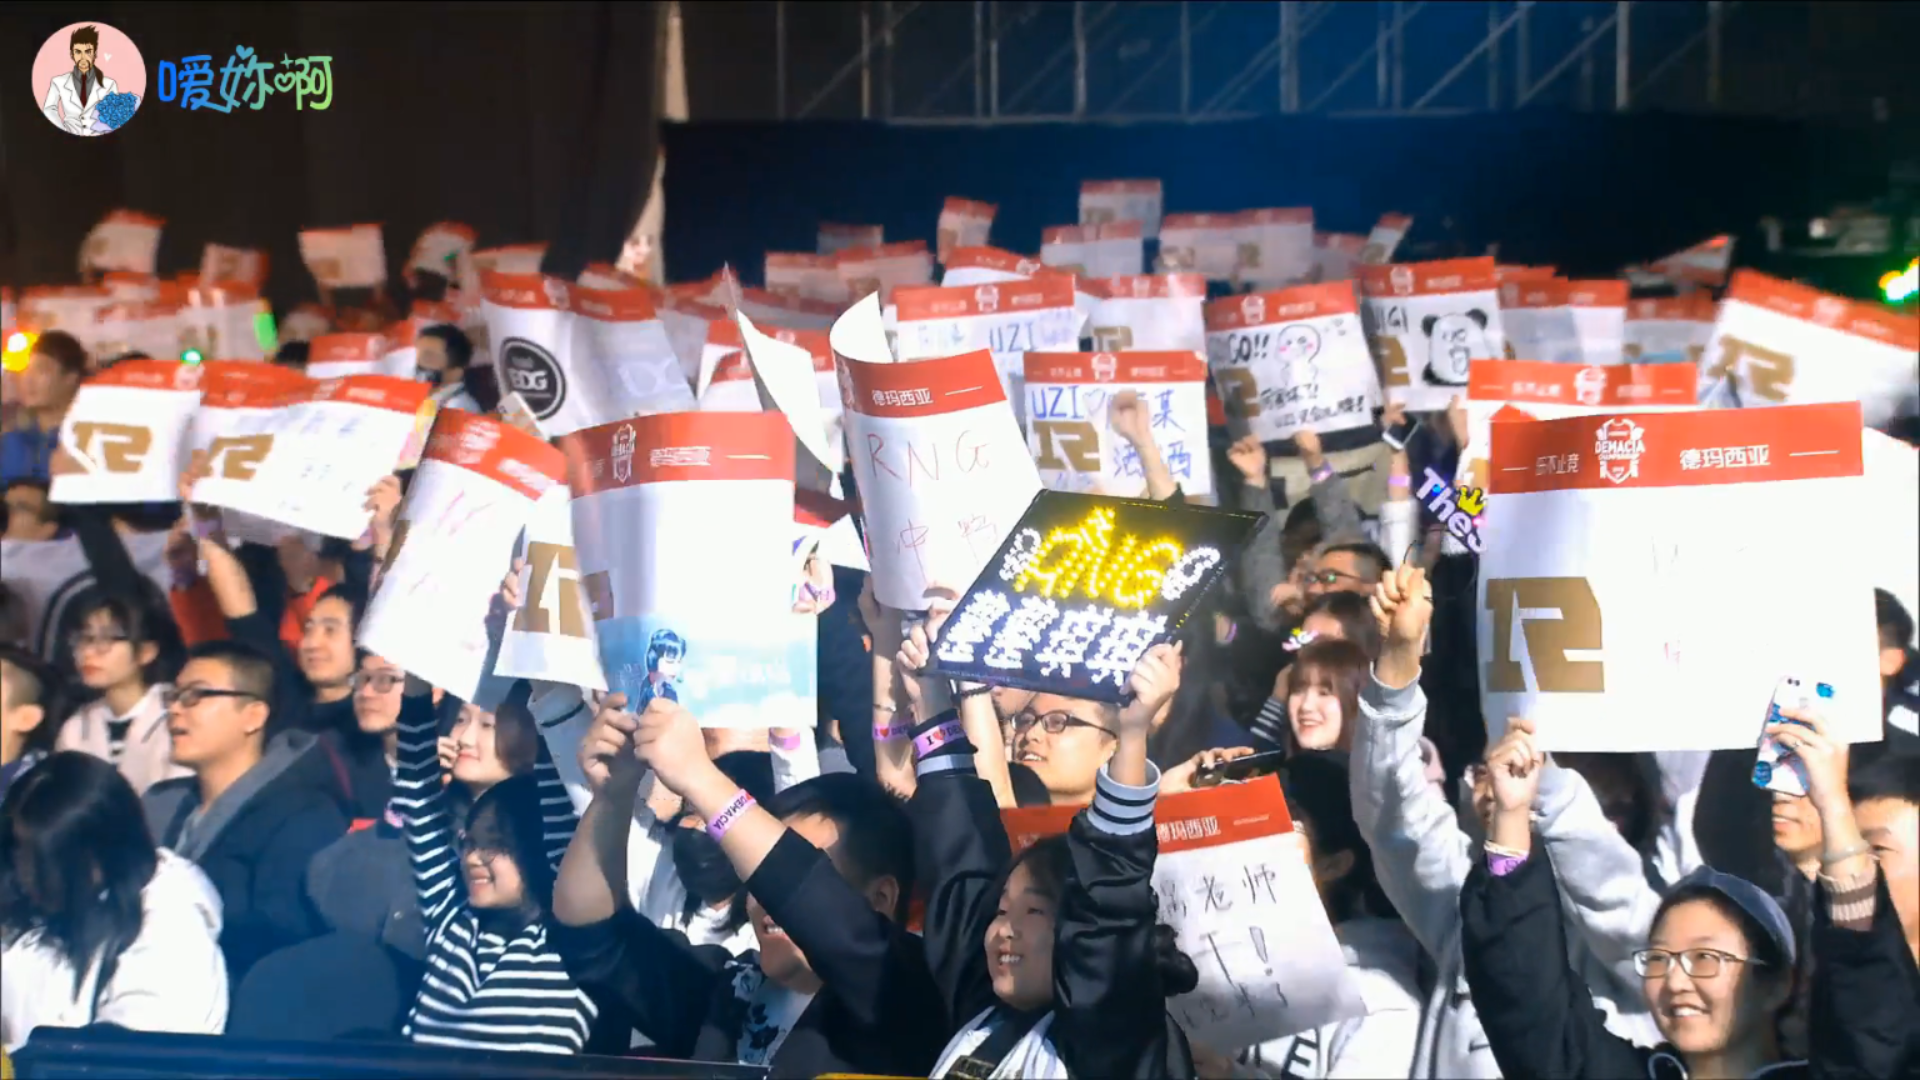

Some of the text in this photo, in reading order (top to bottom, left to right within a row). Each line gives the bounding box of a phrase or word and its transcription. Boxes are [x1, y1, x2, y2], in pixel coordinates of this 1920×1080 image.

[872, 387, 934, 407] 德玛西亚
[1031, 385, 1084, 419] UZI
[867, 429, 990, 487] RNG
[1595, 440, 1646, 454] DEMACIA
[1679, 444, 1771, 471] 德玛西亚
[713, 795, 747, 830] DEMACIA
